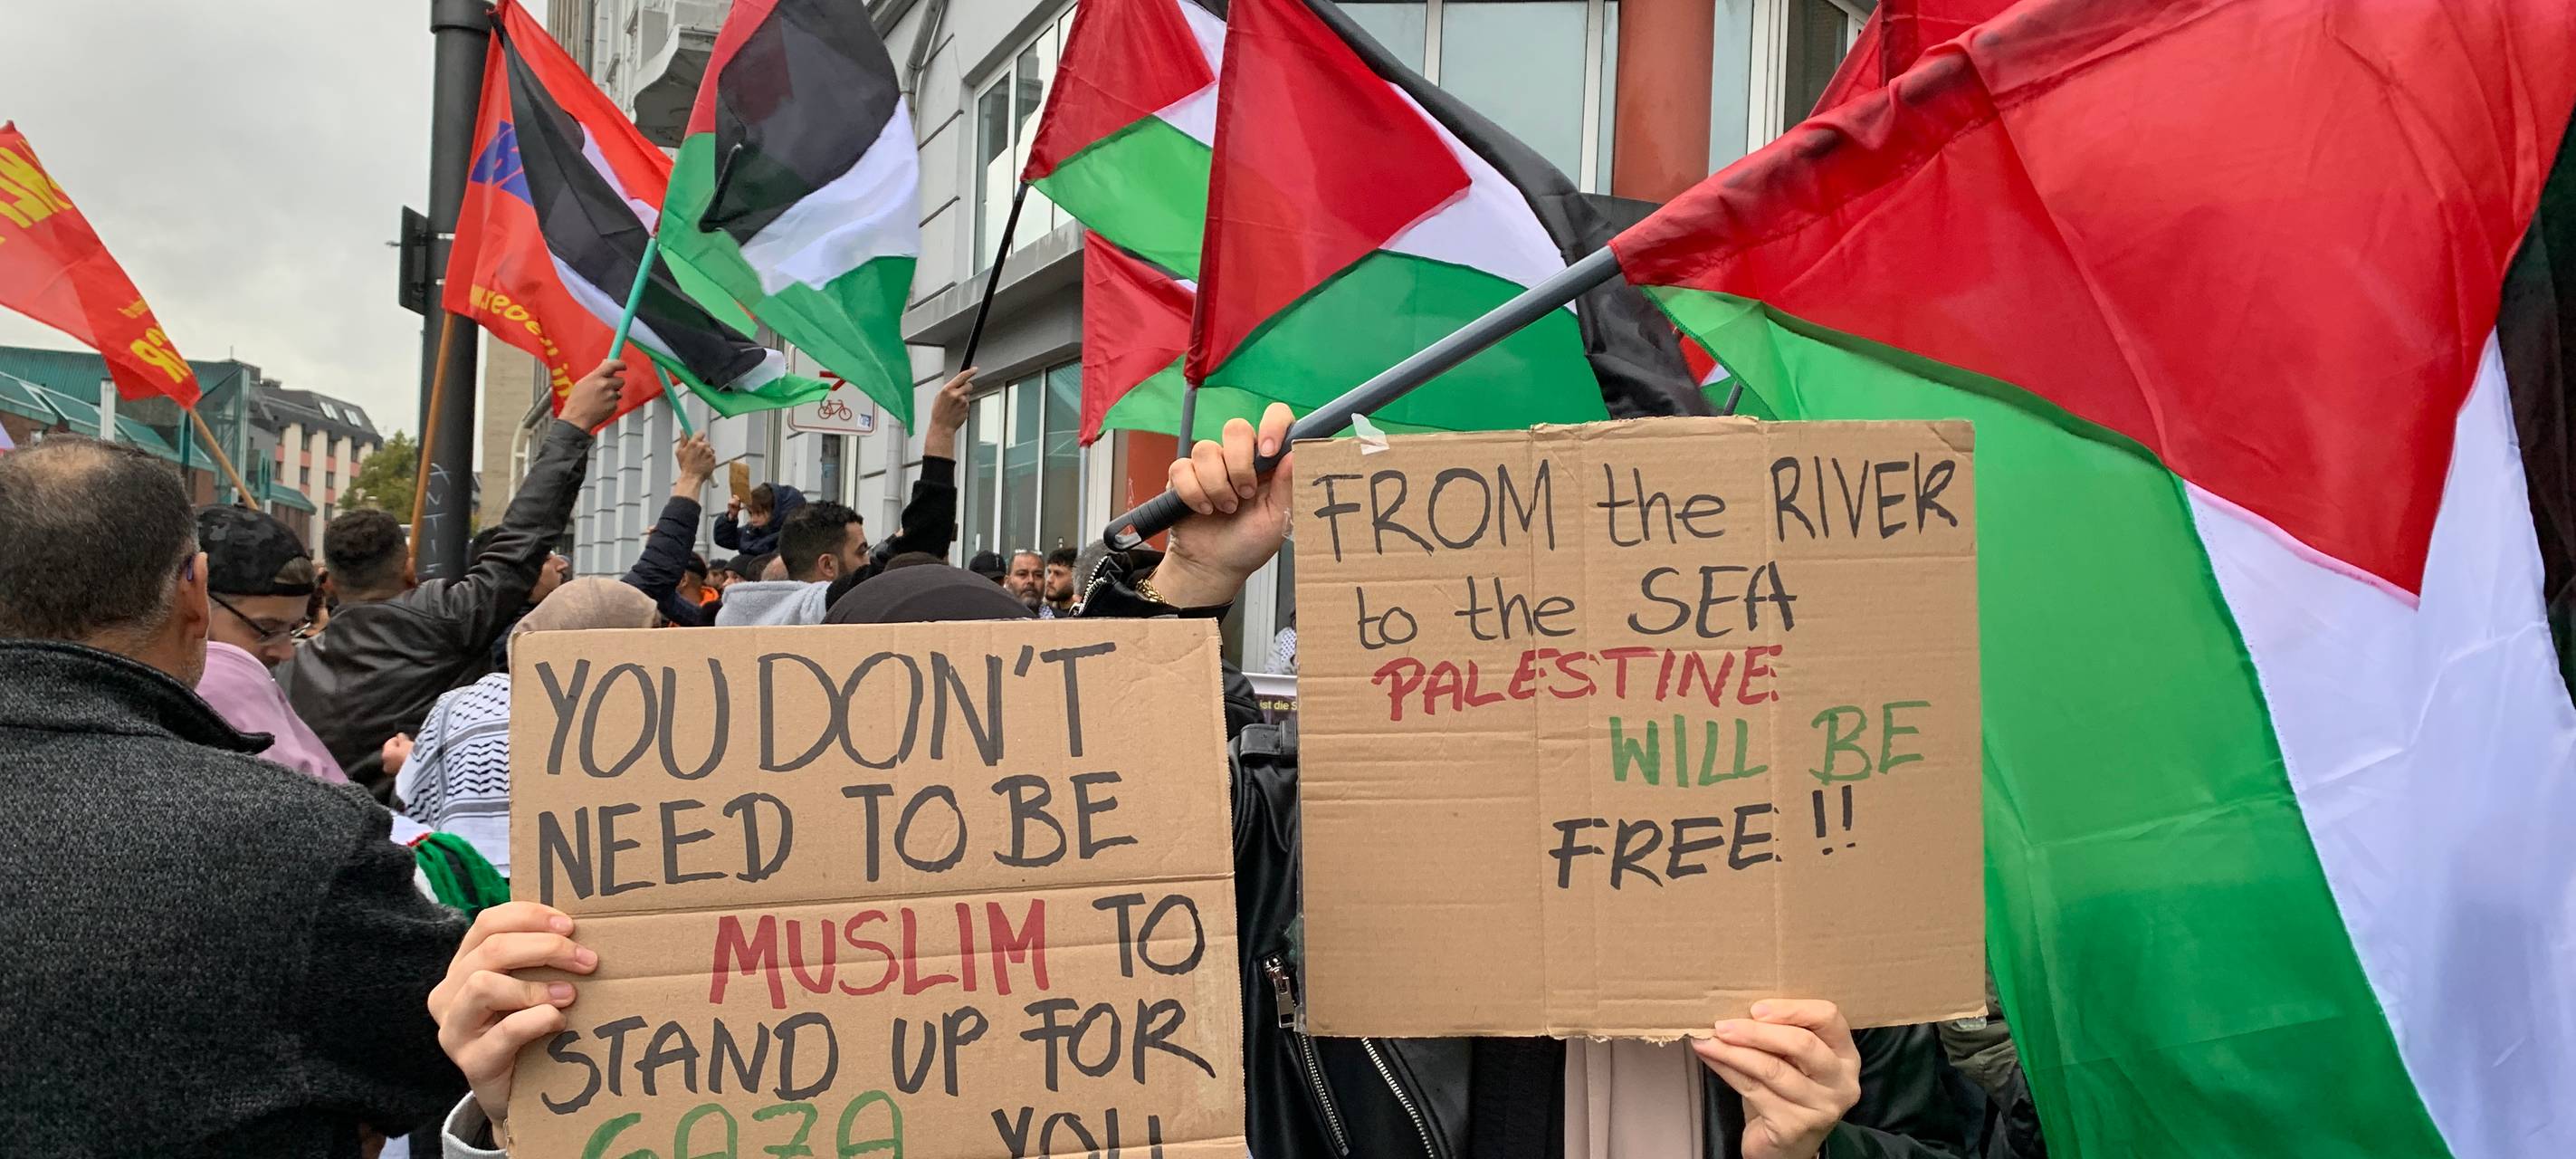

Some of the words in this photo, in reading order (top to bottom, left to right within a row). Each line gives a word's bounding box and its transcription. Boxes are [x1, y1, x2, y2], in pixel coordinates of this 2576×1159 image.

[1312, 459, 1555, 562] FROM
[1597, 464, 1726, 548] the
[1771, 453, 1958, 543] RIVER
[1357, 587, 1417, 650] to
[1455, 576, 1576, 640] the
[1627, 560, 1797, 639] SEA
[536, 658, 730, 781] YOU
[758, 642, 1117, 772] DON'T
[1274, 700, 1290, 710] die
[1372, 645, 1782, 722] PALESTINE
[1610, 715, 1768, 788] WILL
[1810, 700, 1930, 785] BE
[539, 791, 793, 905] NEED
[842, 784, 968, 882] TO
[992, 771, 1137, 867] BE
[1549, 802, 1782, 890] FREE
[710, 898, 1050, 1010] MUSLIM
[1092, 894, 1206, 978] TO
[541, 1012, 839, 1116] STAND
[892, 1006, 989, 1097] UP
[1021, 999, 1216, 1092] FOR
